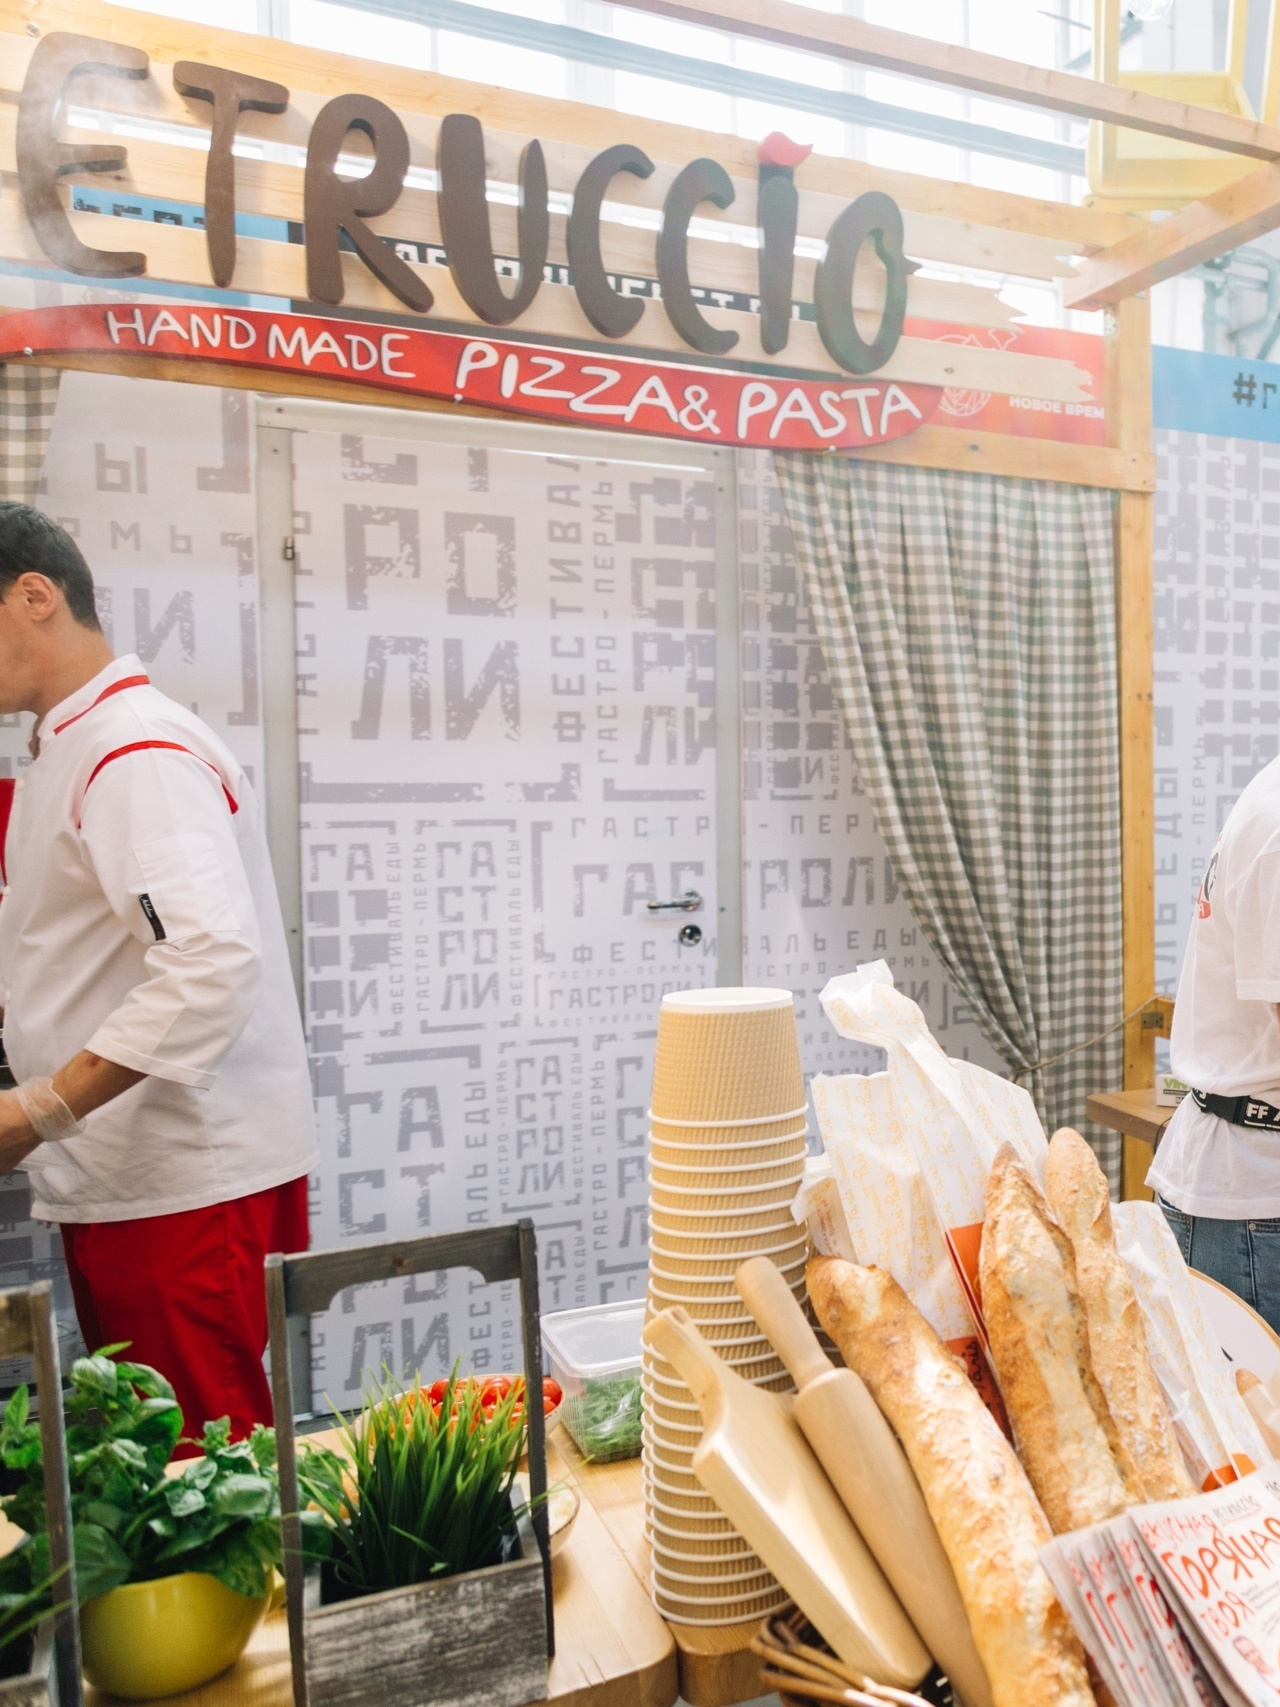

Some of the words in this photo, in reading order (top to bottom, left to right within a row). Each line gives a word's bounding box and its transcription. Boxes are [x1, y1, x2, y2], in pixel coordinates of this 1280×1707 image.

[738, 384, 922, 440] PASTA
[1009, 395, 1062, 413] НОВОЕ
[309, 844, 375, 882] ГА
[436, 840, 496, 879] ГА
[506, 839, 523, 880] ЕДЫ
[412, 843, 431, 1012] ГАСТРО-ПЕРМЬ
[508, 887, 524, 1007] ФЕСТИВАЛЬ
[1200, 1590, 1256, 1644] ТВОЯ
